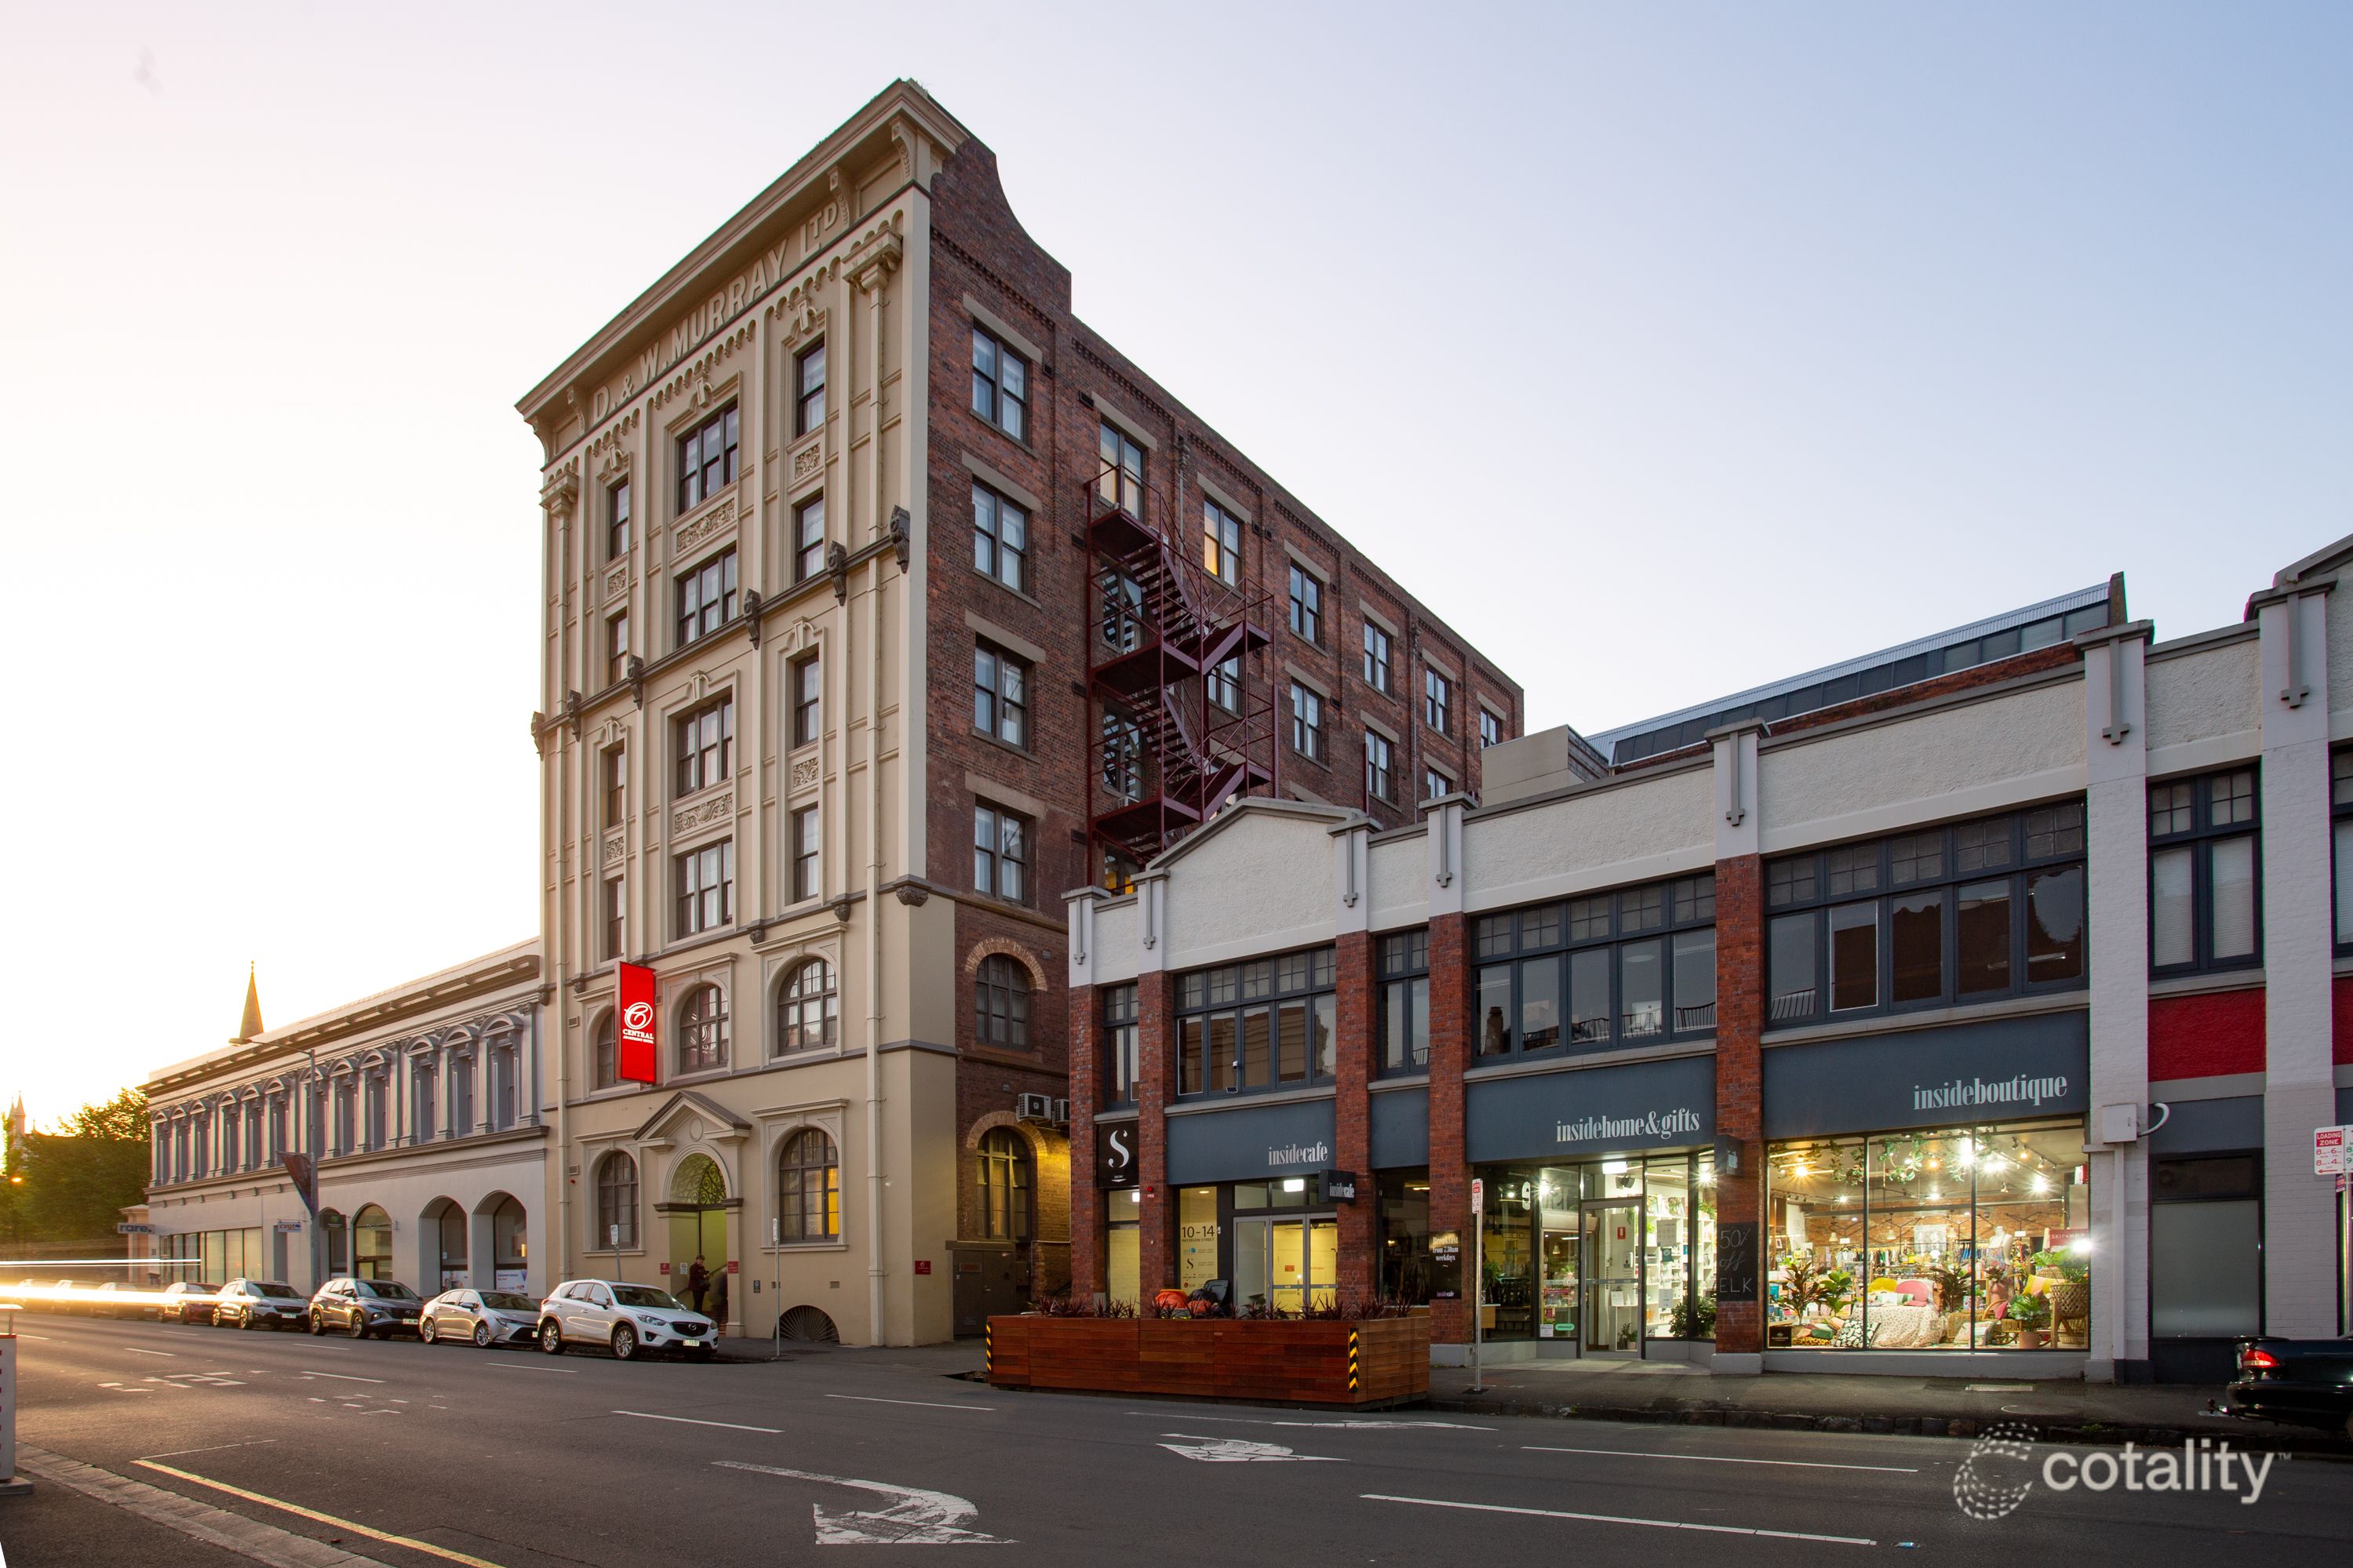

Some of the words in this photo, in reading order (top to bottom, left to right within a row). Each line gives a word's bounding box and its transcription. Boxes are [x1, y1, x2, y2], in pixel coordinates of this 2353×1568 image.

[594, 384, 617, 424] D.
[620, 374, 632, 404] &
[672, 238, 788, 363] MURRAY
[800, 202, 838, 263] LTD
[622, 1028, 654, 1039] CENTRAL
[1913, 1074, 2067, 1110] insideboutique
[1557, 1108, 1700, 1142] insidehome&gifts
[1108, 1130, 1129, 1168] S
[1268, 1141, 1328, 1165] insidecafe
[1329, 1181, 1355, 1199] insidecafe
[1720, 1229, 1751, 1249] 50%
[1719, 1278, 1752, 1293] ELK
